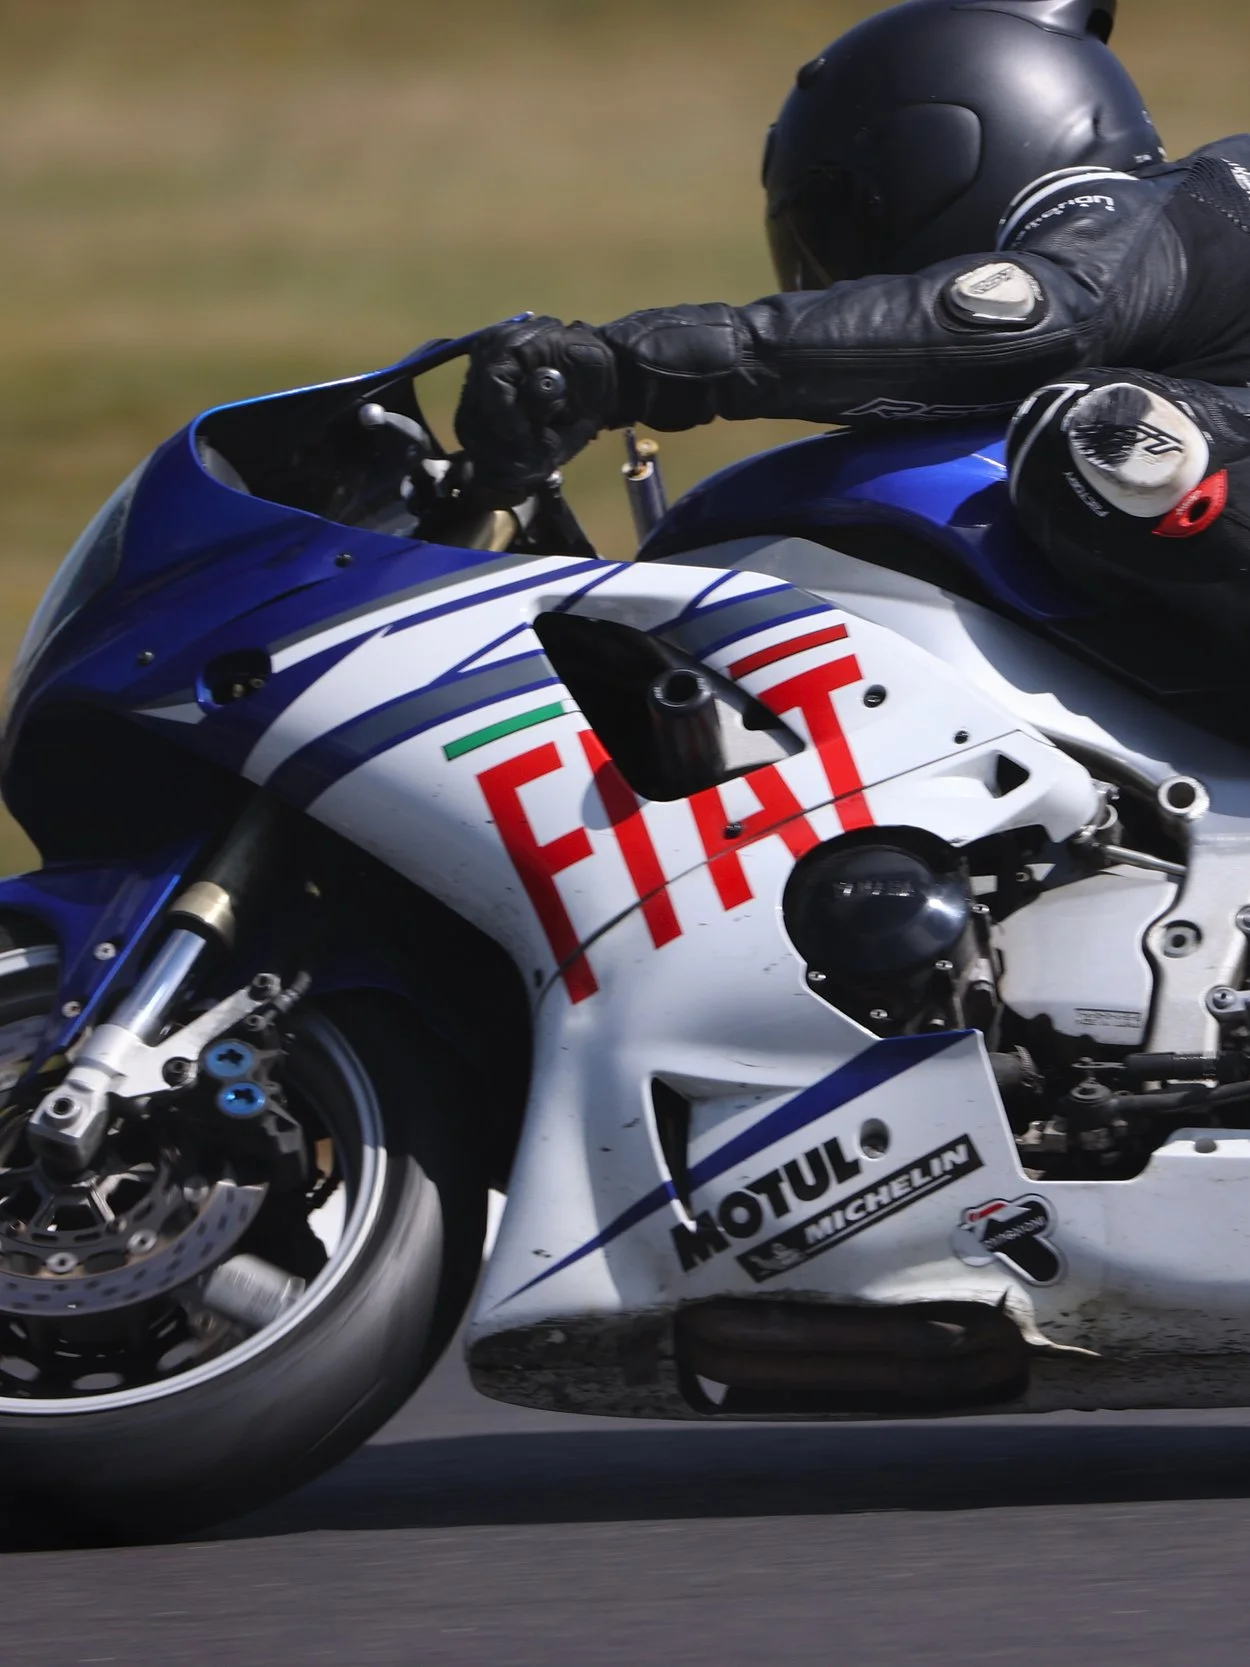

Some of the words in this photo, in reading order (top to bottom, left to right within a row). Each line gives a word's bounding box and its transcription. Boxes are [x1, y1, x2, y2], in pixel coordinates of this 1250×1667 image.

[476, 652, 877, 1006] FIAT
[670, 1136, 863, 1273] MOTUL
[804, 1143, 971, 1245] MICHELIN
